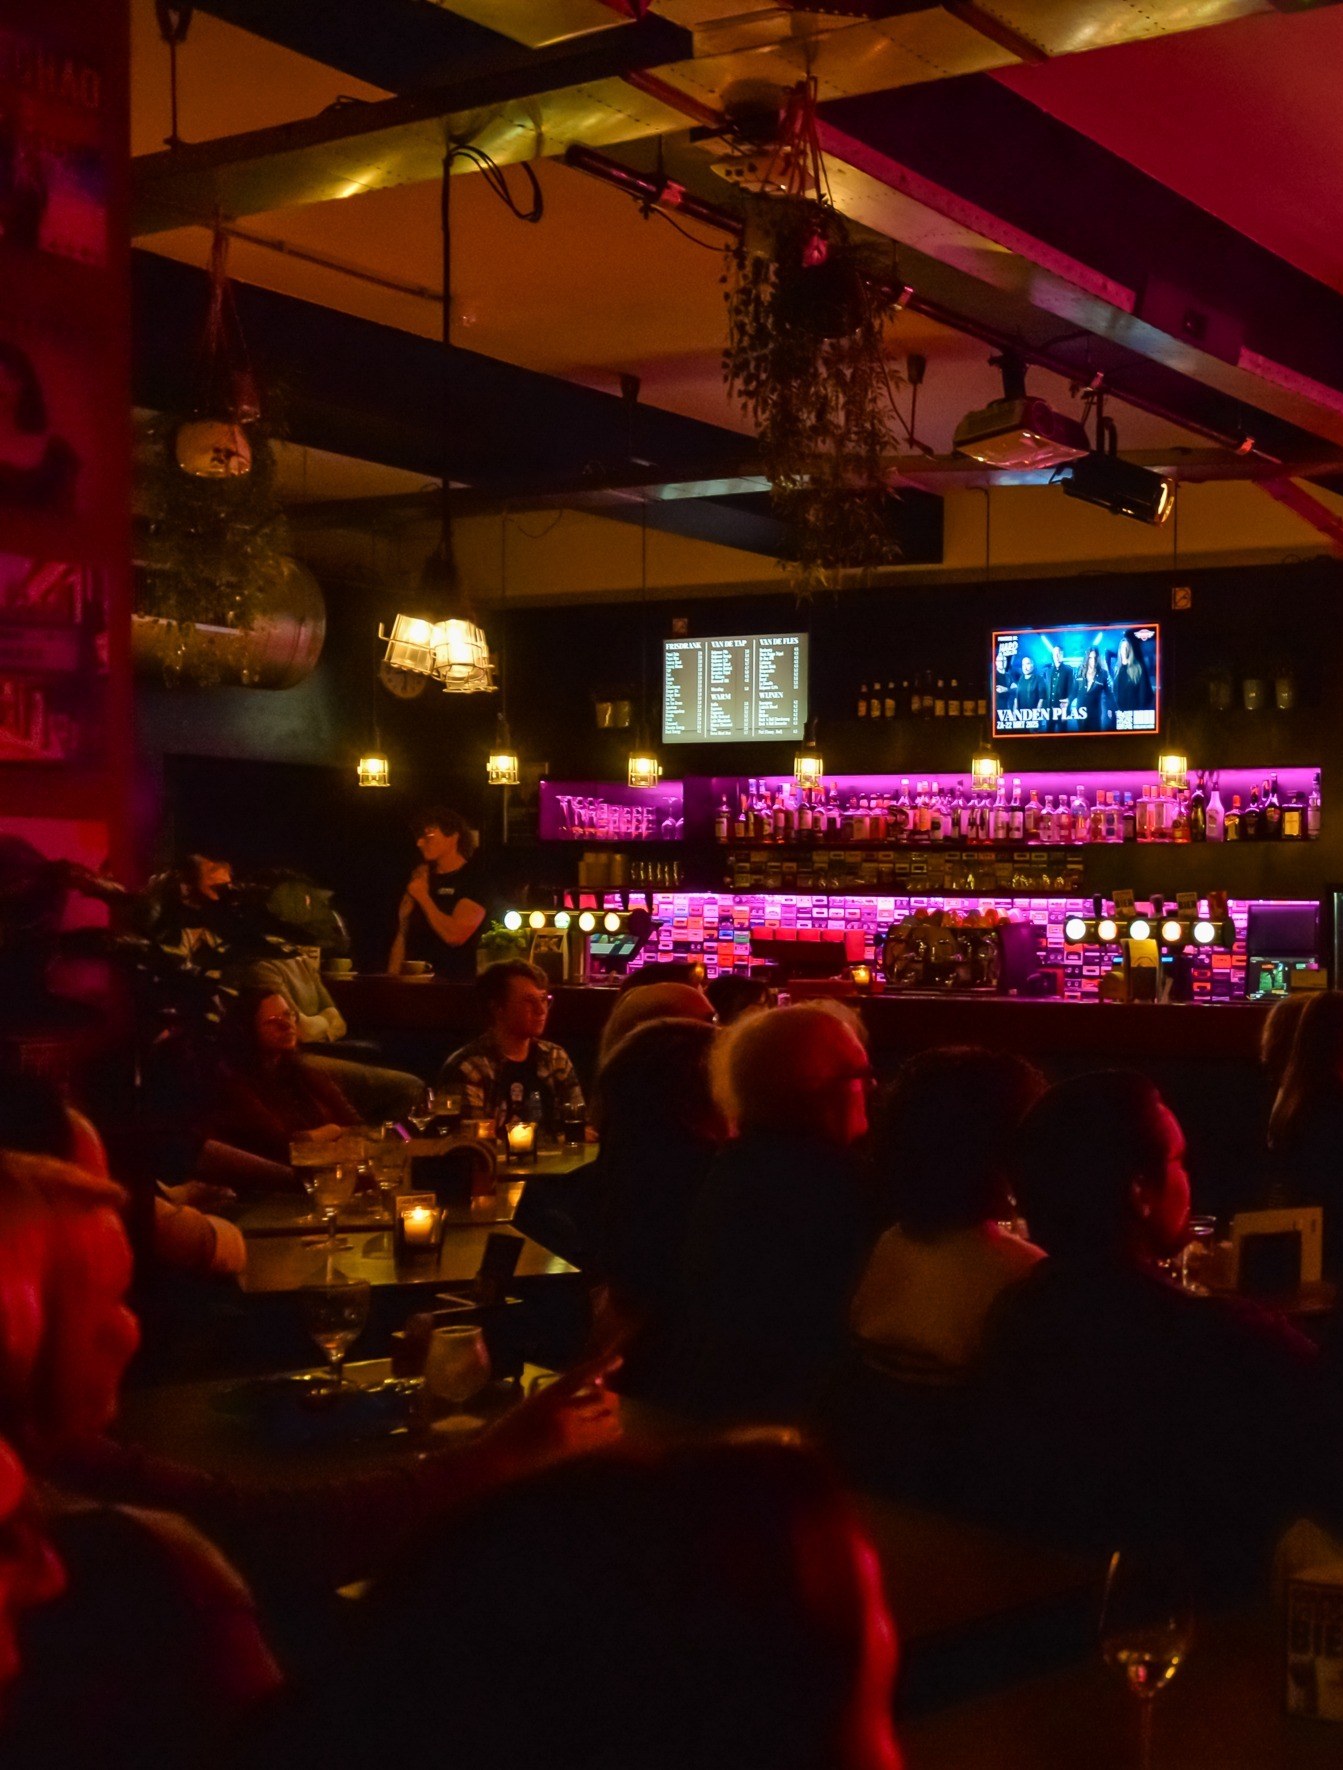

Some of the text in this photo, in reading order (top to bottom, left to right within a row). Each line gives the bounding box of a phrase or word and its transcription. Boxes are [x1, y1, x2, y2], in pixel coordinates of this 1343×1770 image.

[734, 640, 748, 648] TAP
[783, 637, 799, 645] FLES
[665, 642, 702, 650] FRISDRANK
[711, 693, 731, 701] WARM
[759, 691, 784, 699] WIJNEN
[996, 706, 1088, 722] VANDEN PLAS
